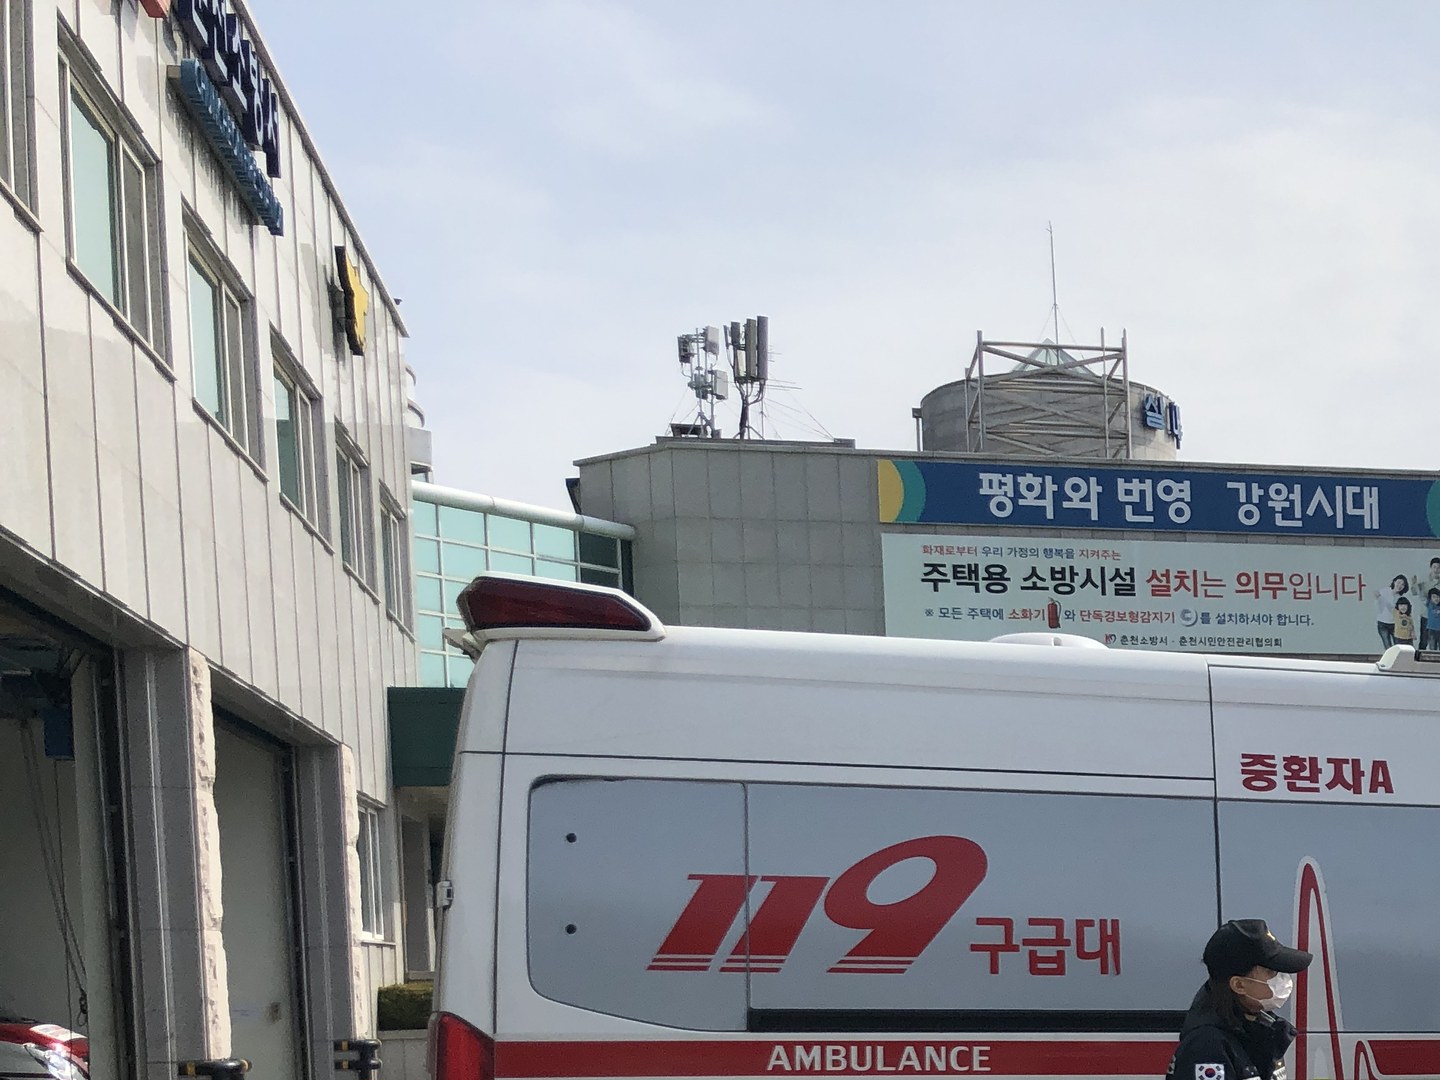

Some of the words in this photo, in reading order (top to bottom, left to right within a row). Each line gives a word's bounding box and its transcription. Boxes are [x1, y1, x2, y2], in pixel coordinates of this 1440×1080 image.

[979, 473, 1103, 521] 평화와
[1117, 478, 1191, 524] 번영
[1226, 481, 1380, 530] 강원시대
[922, 545, 978, 557] 화재로부터
[981, 546, 1003, 557] 우리
[1007, 547, 1040, 558] 가정의
[1043, 548, 1075, 560] 행복을
[1079, 549, 1122, 561] 지켜주는
[921, 563, 1011, 594] 주택용
[1020, 565, 1137, 597] 소방시설
[1146, 568, 1227, 598] 설치는
[1235, 571, 1366, 601] 의무입니다
[938, 607, 963, 620] 모든
[967, 608, 1004, 621] 주택에
[1008, 609, 1046, 621] 소화기
[1064, 609, 1076, 621] 와
[1080, 609, 1176, 625] 단독경보형감지기
[1200, 612, 1211, 625] 를
[1215, 613, 1273, 626] 설치하셔야
[1277, 613, 1315, 626] 합니다.
[1120, 634, 1168, 646] 춘천소방서
[1240, 753, 1394, 795] 중환자A
[645, 835, 988, 974] 119
[970, 917, 1121, 976] 구급대
[767, 1045, 992, 1072] AMBULANCE
